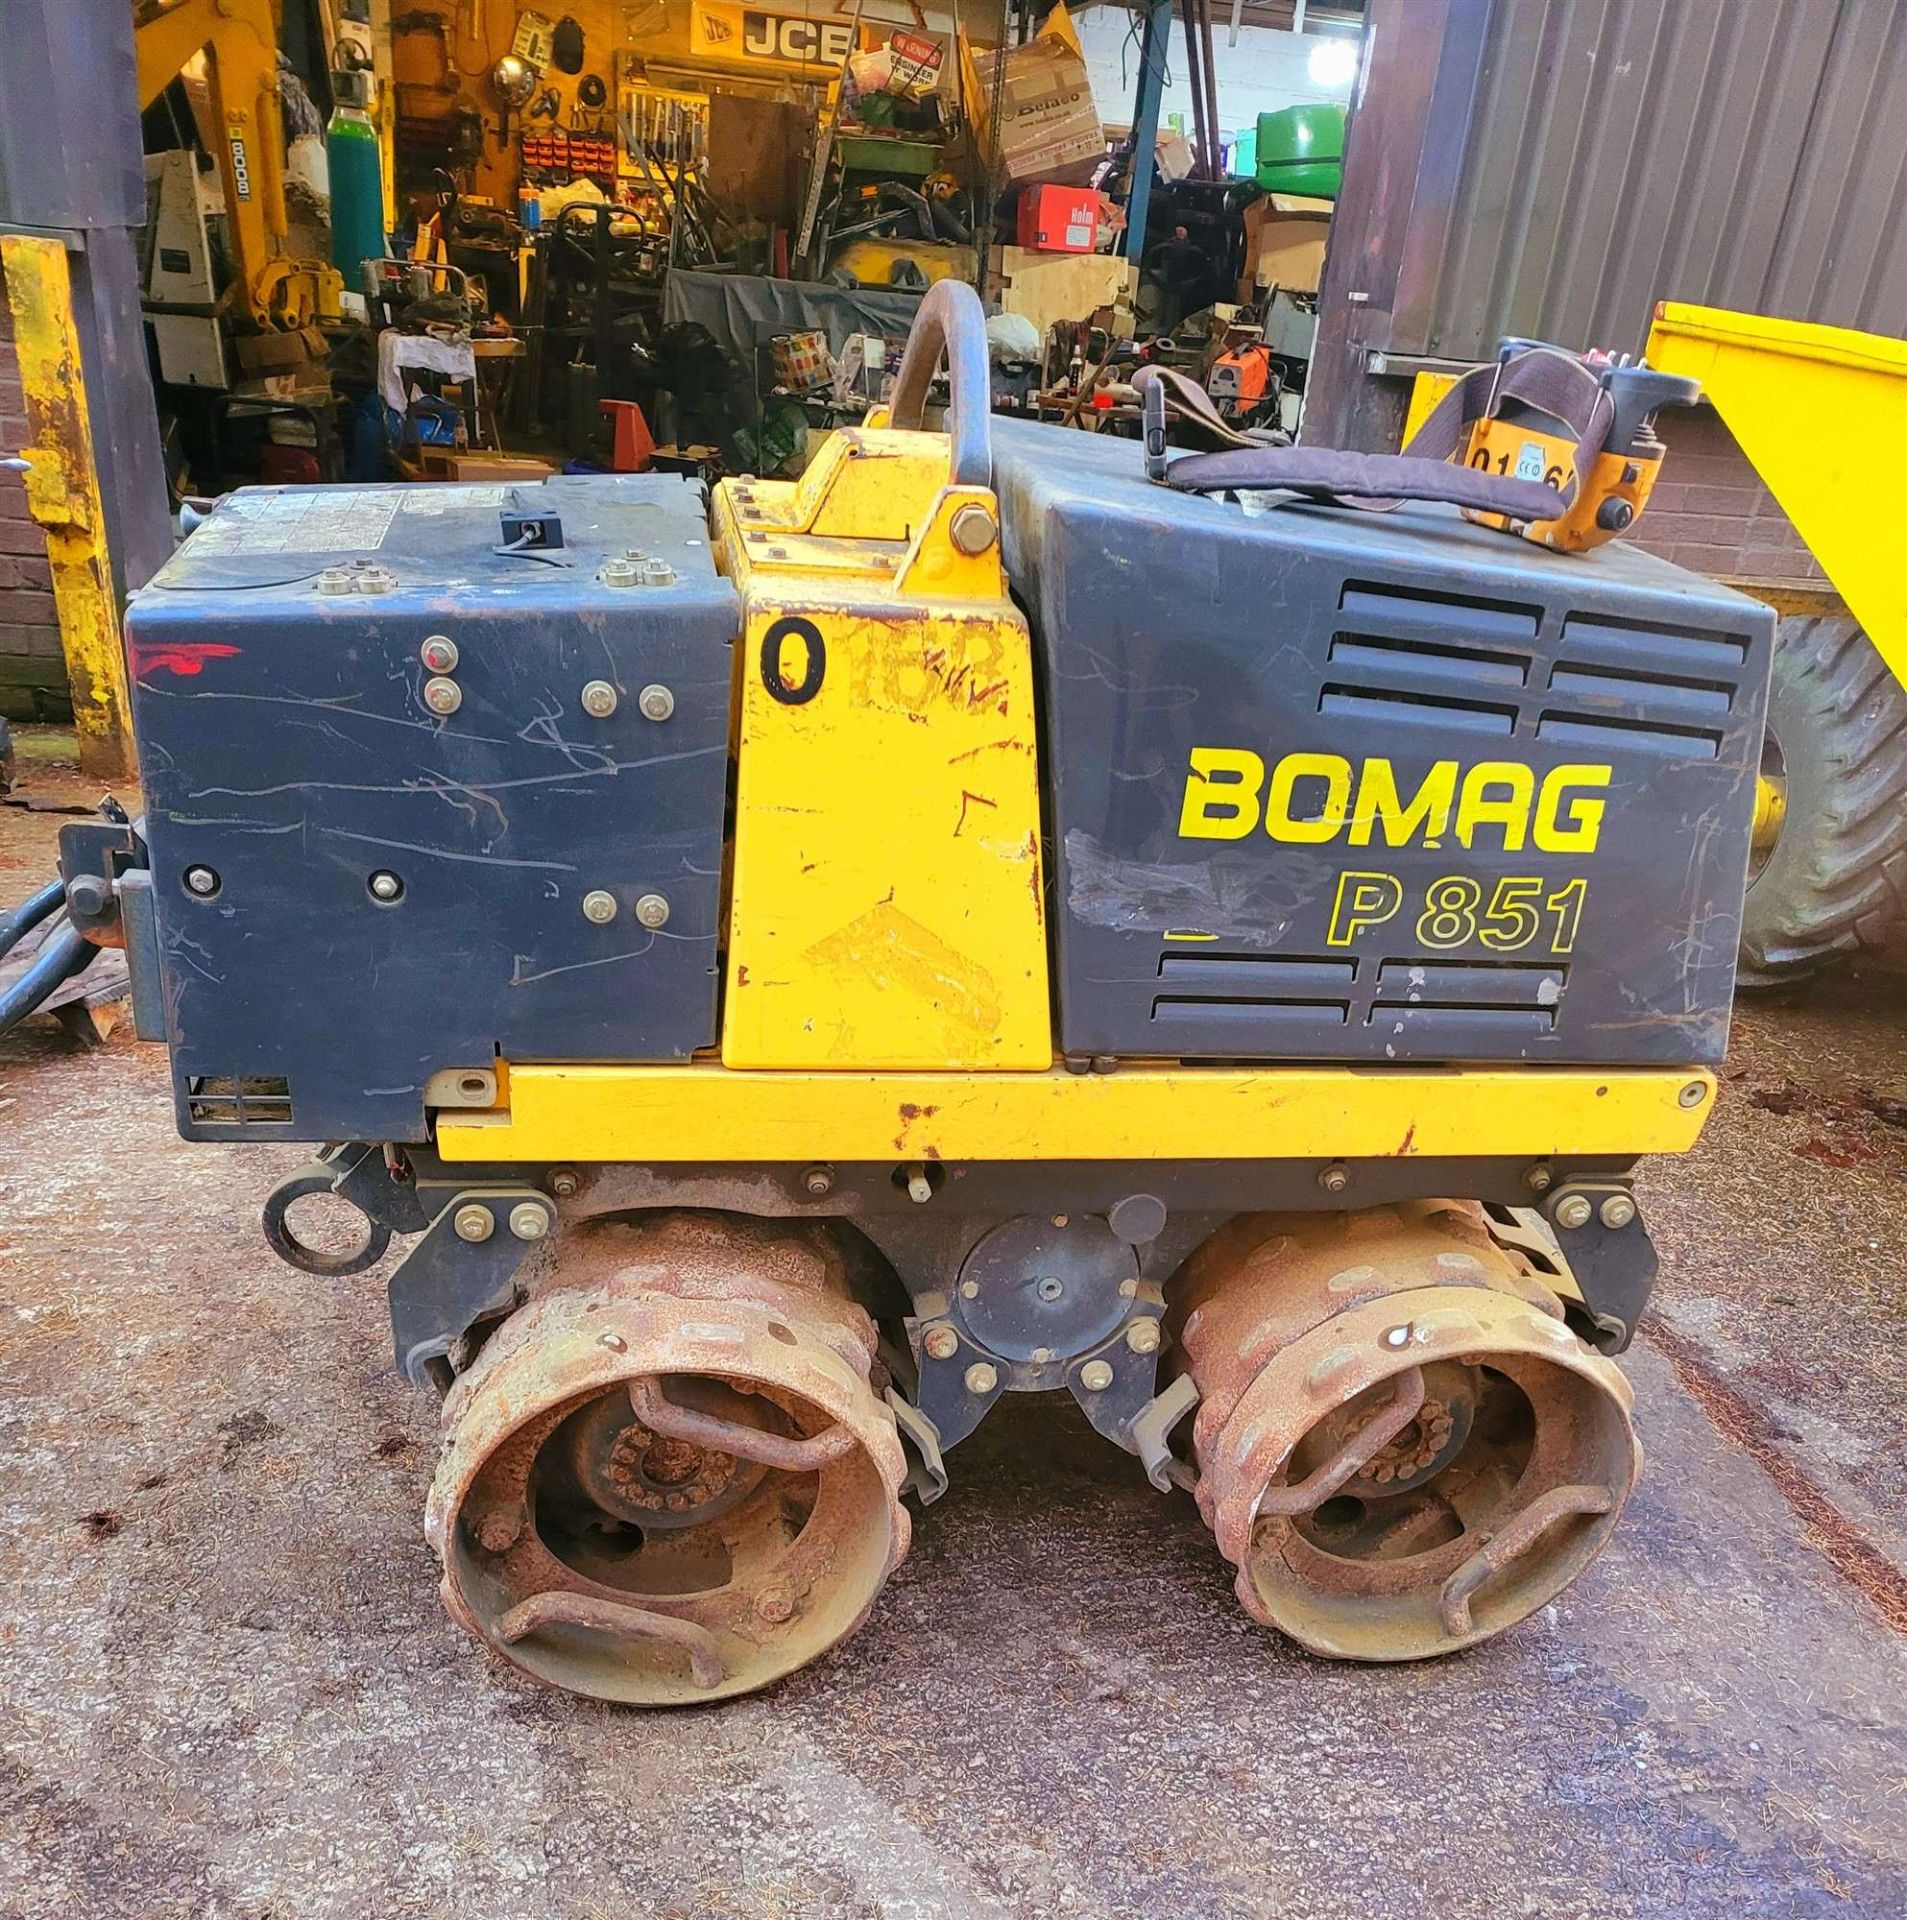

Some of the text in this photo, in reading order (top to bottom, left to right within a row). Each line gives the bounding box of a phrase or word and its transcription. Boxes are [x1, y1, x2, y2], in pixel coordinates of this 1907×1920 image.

[705, 16, 732, 41] JCB
[746, 17, 853, 63] JCB
[896, 37, 940, 64] WARNING
[232, 142, 249, 194] 8008
[1071, 203, 1094, 225] Holm
[1179, 747, 1613, 853] BOMAG
[1416, 876, 1588, 953] 851
